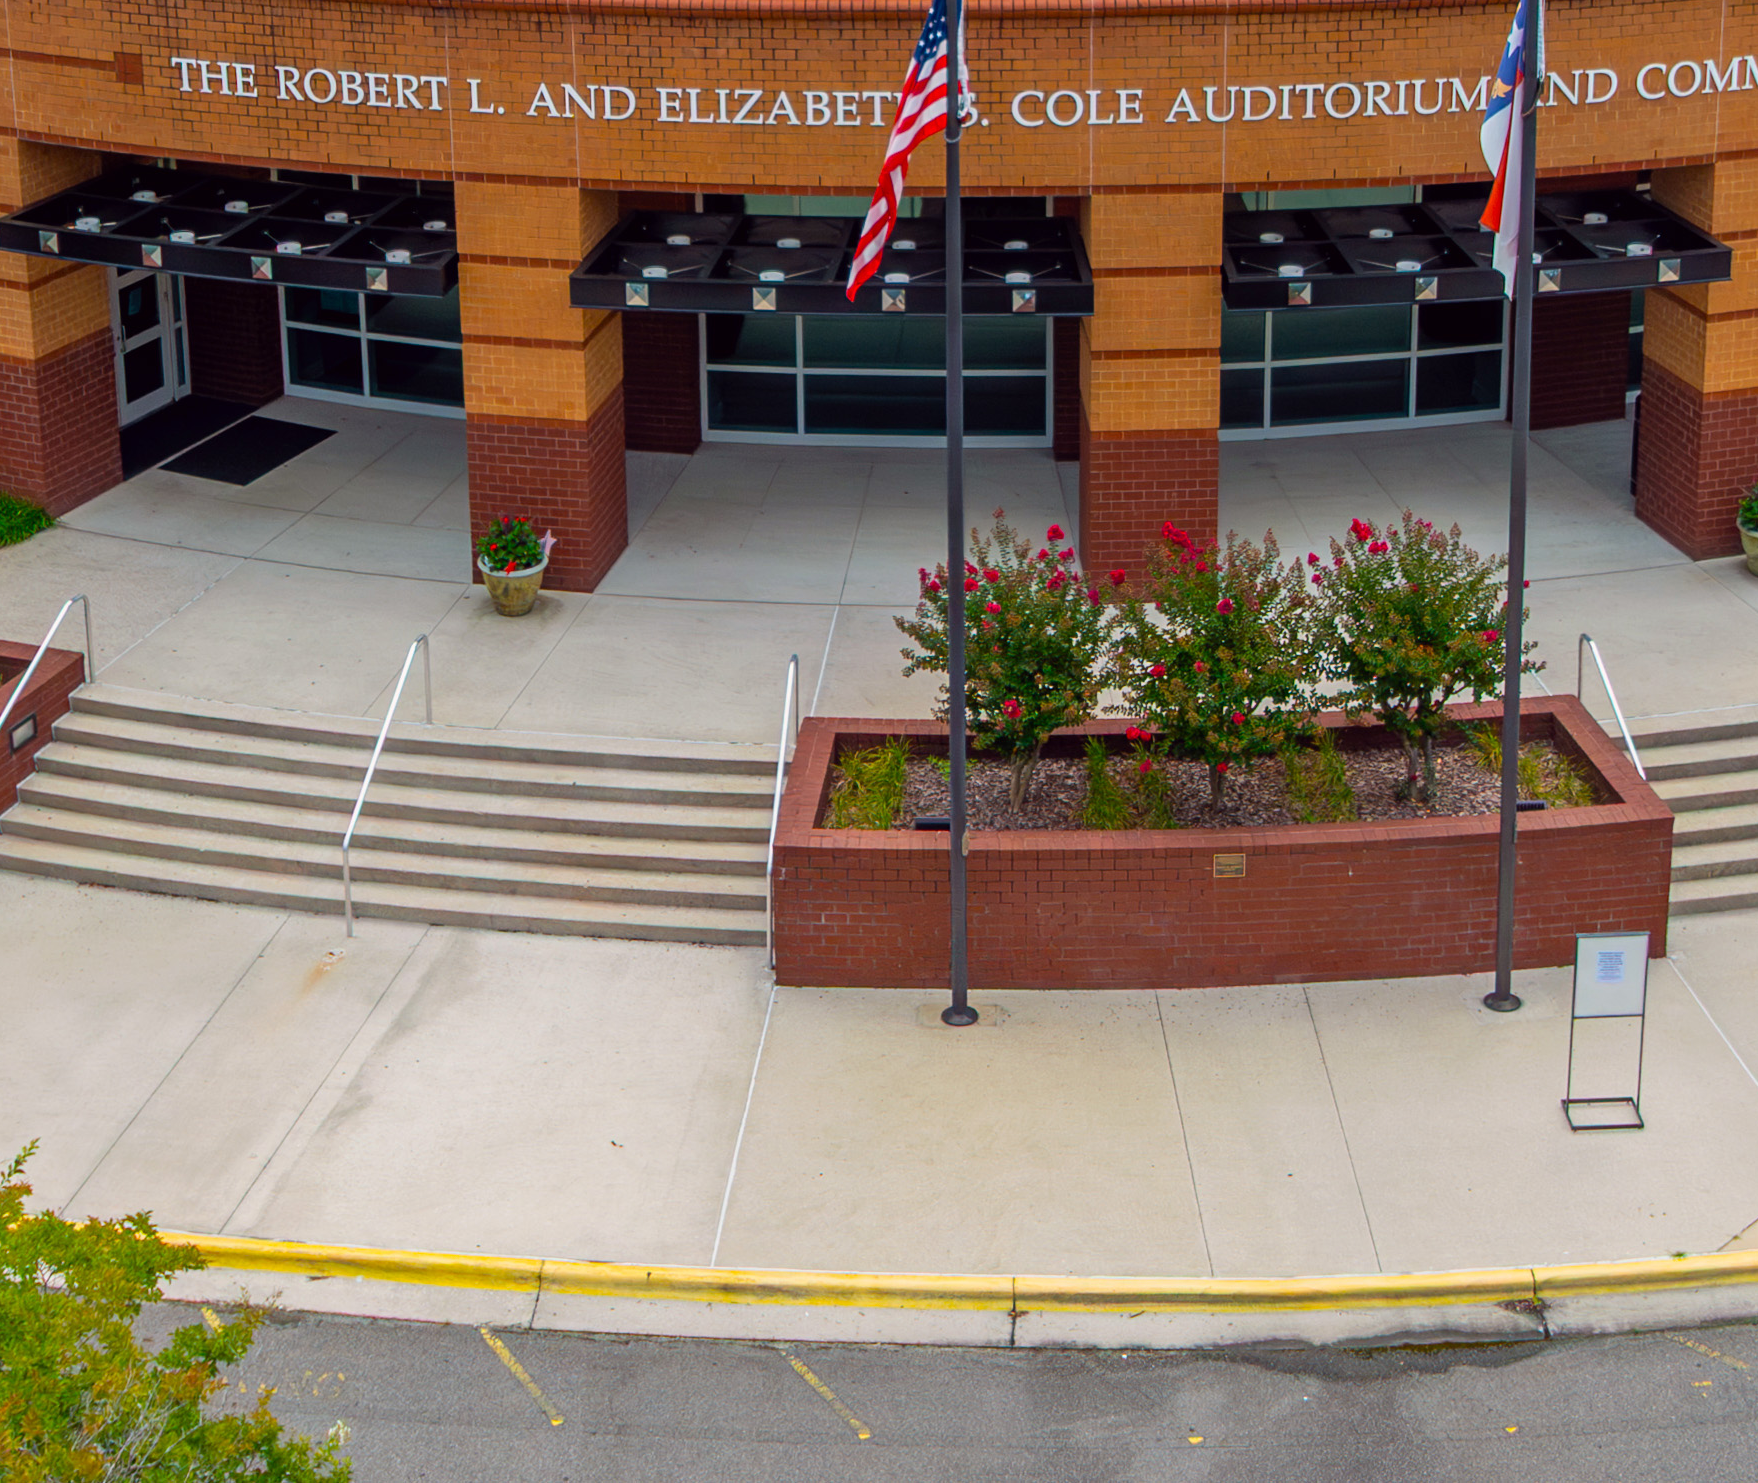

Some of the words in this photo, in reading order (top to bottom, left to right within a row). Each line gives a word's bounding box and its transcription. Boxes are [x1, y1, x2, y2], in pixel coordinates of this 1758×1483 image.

[171, 56, 258, 98] THE
[274, 65, 447, 111] ROBERT
[466, 78, 506, 115] L.
[526, 82, 637, 120] AND
[655, 87, 903, 127] ELIZABET
[1010, 89, 1144, 127] COLE
[1164, 75, 1492, 124] AUDITORIUM
[1535, 67, 1619, 107] ND
